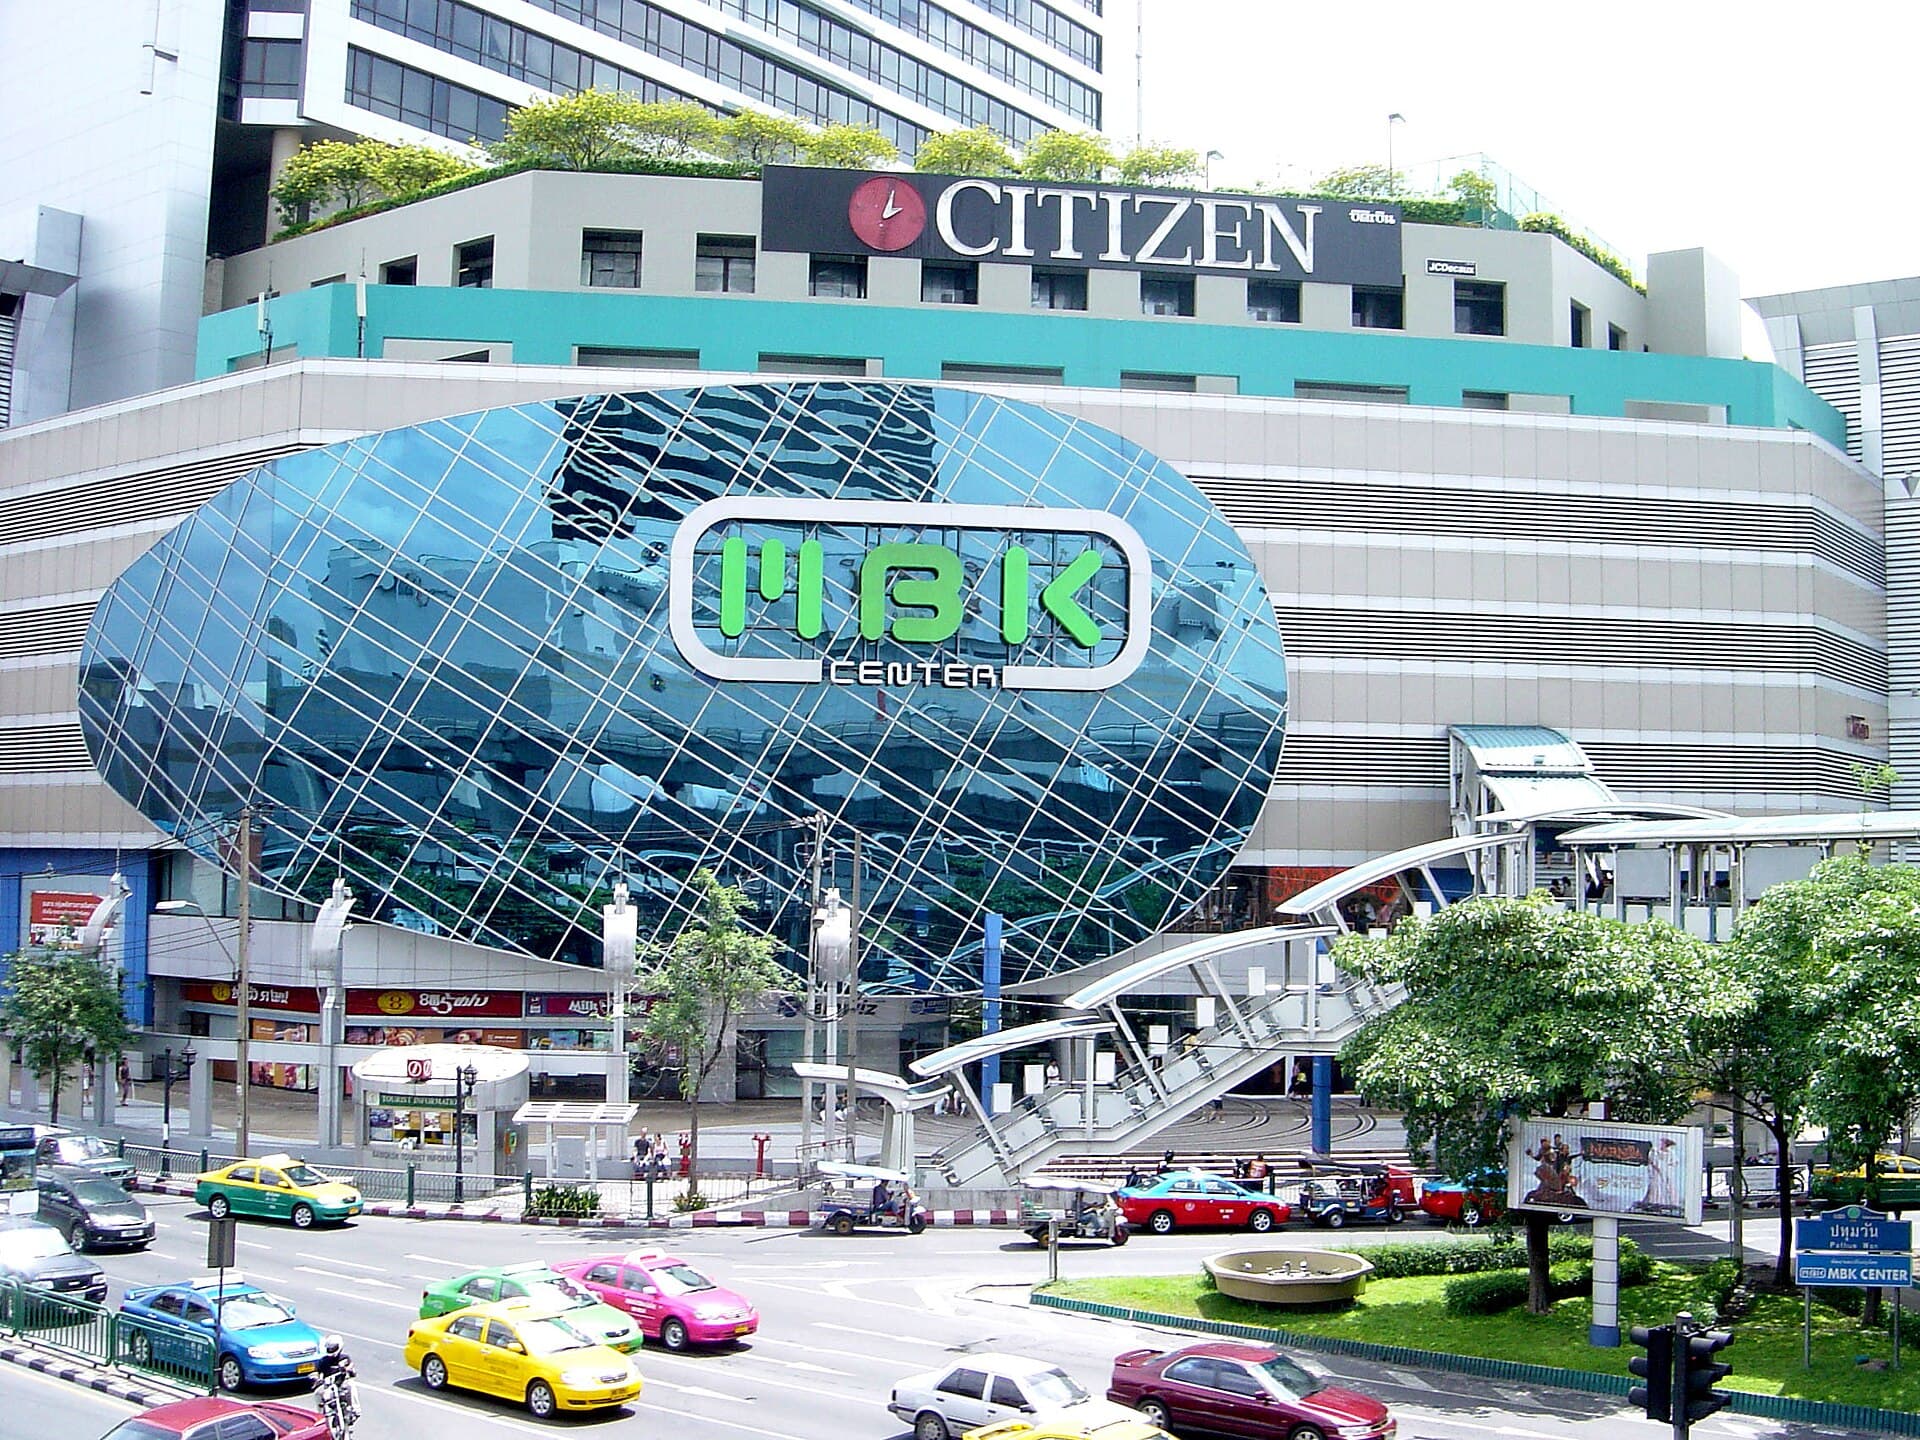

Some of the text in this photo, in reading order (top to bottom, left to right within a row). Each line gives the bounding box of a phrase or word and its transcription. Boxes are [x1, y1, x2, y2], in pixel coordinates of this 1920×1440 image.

[935, 179, 1323, 274] CITIZEN
[1429, 262, 1475, 274] JCDecaux
[720, 536, 1102, 648] MBK
[830, 660, 998, 688] CENTER
[568, 1000, 599, 1014] Milk
[1830, 1222, 1879, 1241] ปทุมวัน
[1827, 1268, 1857, 1280] MBK
[1860, 1269, 1908, 1281] CENTER
